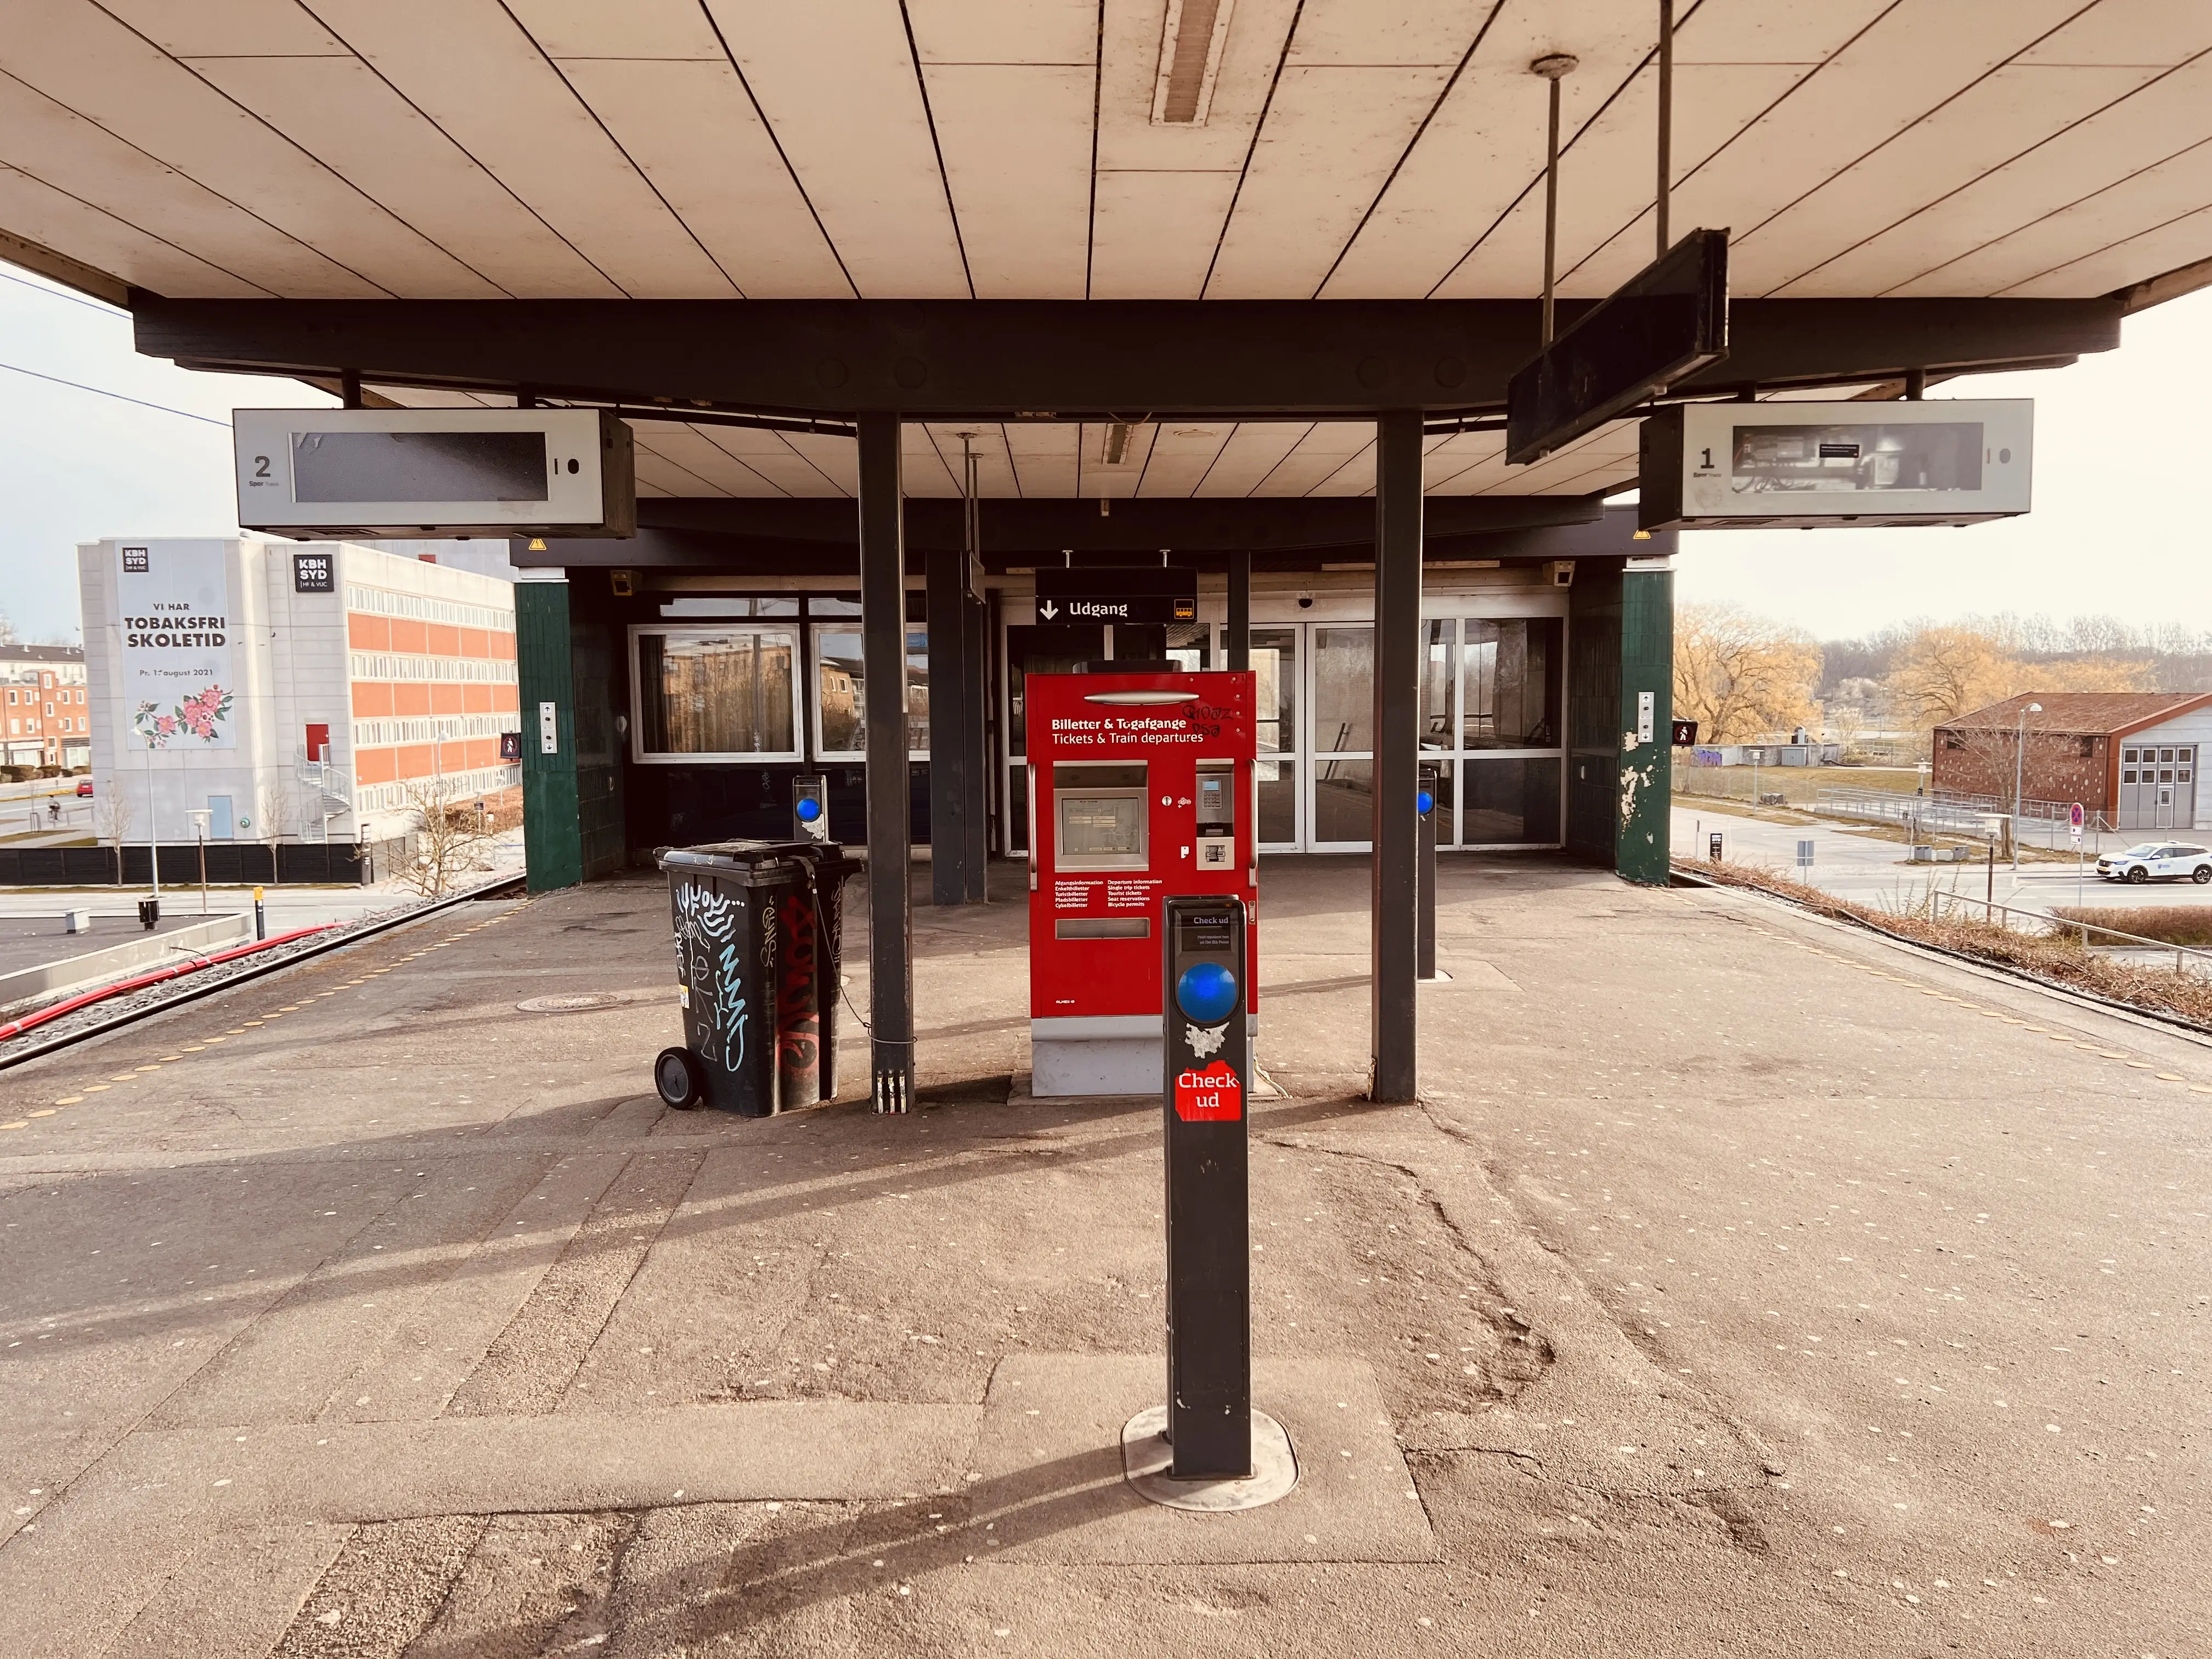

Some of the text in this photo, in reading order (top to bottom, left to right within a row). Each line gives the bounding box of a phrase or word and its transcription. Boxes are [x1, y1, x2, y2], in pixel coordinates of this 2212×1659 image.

[1701, 448, 1714, 469] 1
[255, 455, 270, 477] 2
[298, 559, 326, 569] KBH
[300, 569, 328, 580] SYD
[1070, 602, 1128, 617] Udgang
[124, 617, 225, 629] TOBAKSFRI
[127, 634, 225, 647] SKOLETID
[1052, 719, 1101, 730] Billetter
[1104, 718, 1113, 729] &
[1116, 718, 1187, 730] Togafgange
[1052, 732, 1204, 745] Tickets & Train departures
[1178, 1073, 1238, 1088] Check
[1196, 1093, 1220, 1107] ud
